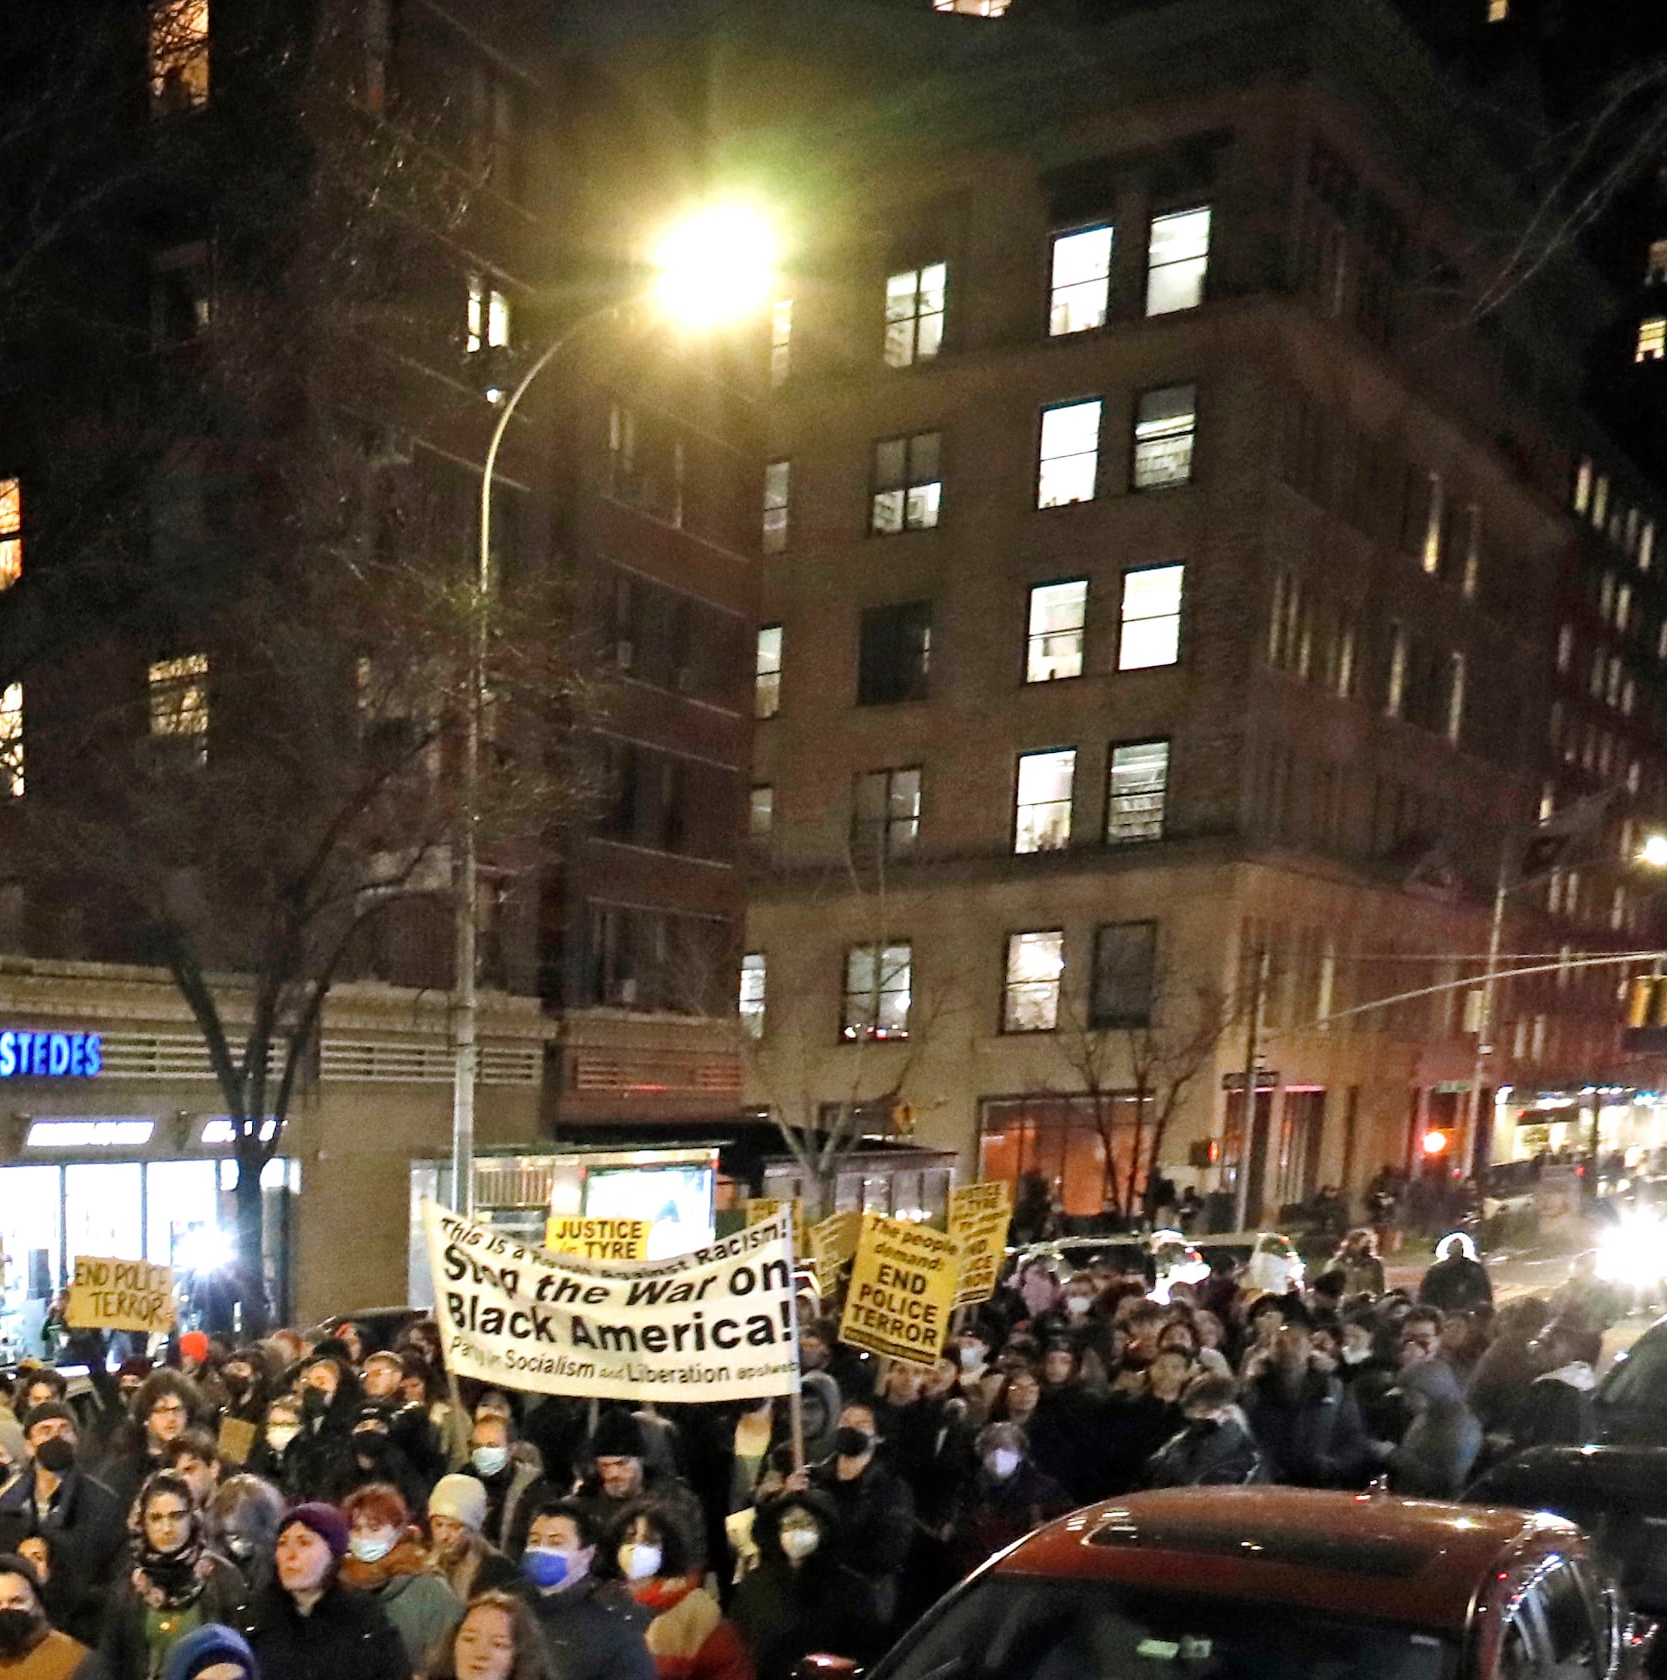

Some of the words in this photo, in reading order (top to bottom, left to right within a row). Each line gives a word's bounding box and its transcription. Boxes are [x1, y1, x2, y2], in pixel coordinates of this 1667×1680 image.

[440, 1217, 484, 1246] This
[695, 1217, 787, 1265] Racism!
[556, 1221, 643, 1240] JUSTICE
[870, 1217, 900, 1239] The
[901, 1231, 959, 1256] people
[586, 1241, 638, 1260] TYRE
[74, 1261, 110, 1286] END
[113, 1262, 168, 1297] POLICE
[443, 1243, 520, 1299] Stop
[535, 1273, 611, 1305] the
[624, 1273, 717, 1307] War
[729, 1258, 790, 1297] on
[877, 1263, 927, 1295] END
[446, 1291, 557, 1344] Black
[571, 1300, 793, 1353] America!
[859, 1283, 939, 1324] POLICE
[851, 1303, 938, 1348] TERROR
[504, 1349, 595, 1379] Socialism
[627, 1362, 730, 1384] Liberation
